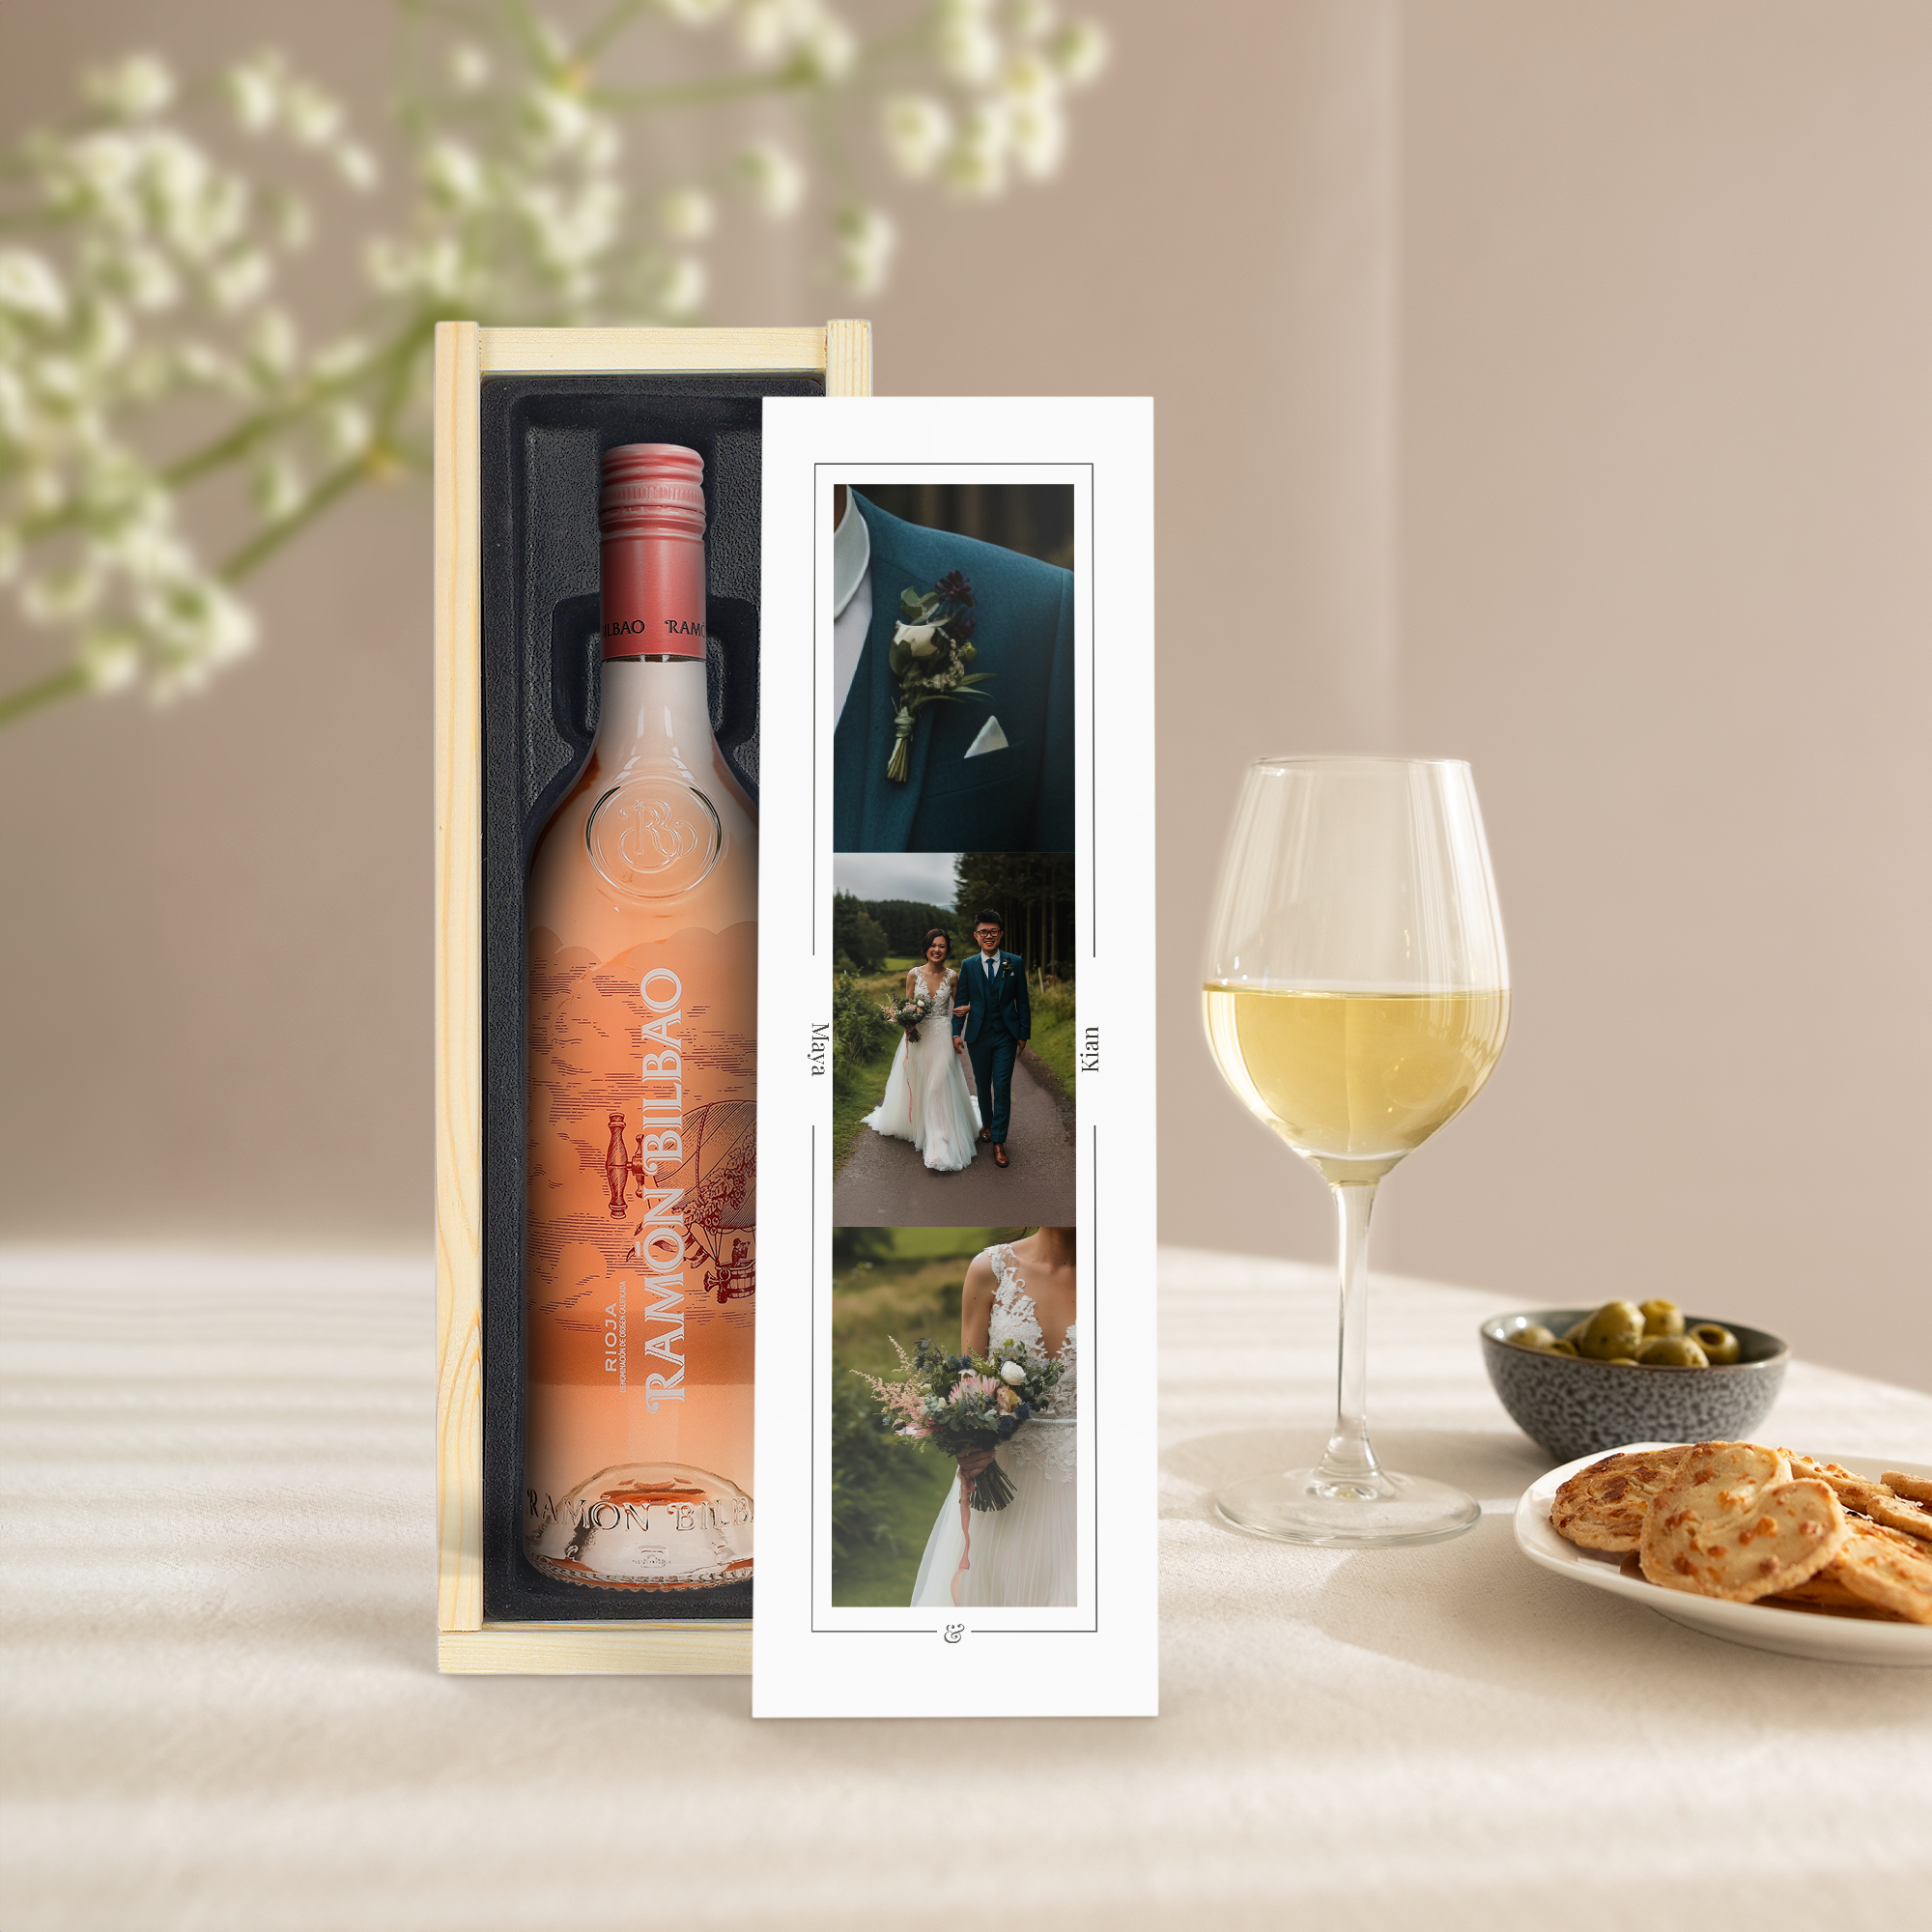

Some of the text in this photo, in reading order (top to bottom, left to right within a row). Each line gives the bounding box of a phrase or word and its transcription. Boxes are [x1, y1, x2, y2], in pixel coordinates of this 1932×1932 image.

[640, 968, 683, 1176] BILBAO
[808, 1023, 830, 1077] Maya
[1080, 1026, 1099, 1072] Kian
[605, 1302, 617, 1372] RIOJA
[619, 1338, 627, 1348] DE
[667, 1496, 753, 1532] BILB
[944, 1624, 965, 1643] &
